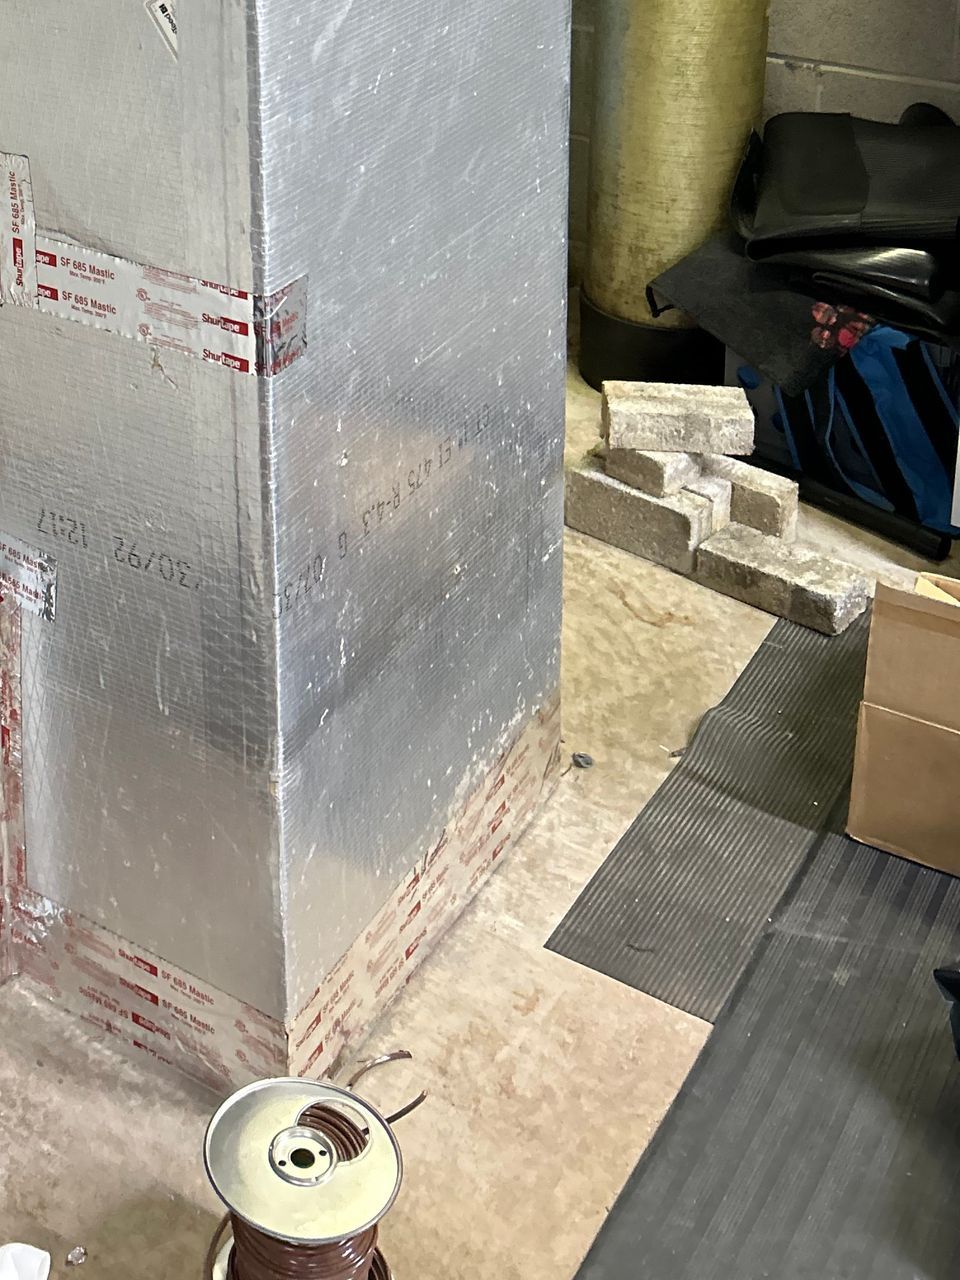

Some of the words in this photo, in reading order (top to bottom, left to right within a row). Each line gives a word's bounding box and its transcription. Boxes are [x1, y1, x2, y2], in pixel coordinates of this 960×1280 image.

[7, 170, 18, 201] Mastic
[10, 202, 19, 219] 685
[11, 220, 20, 234] SF
[12, 247, 24, 287] Shurtape
[60, 257, 71, 268] SF
[73, 260, 87, 273] 685
[89, 265, 115, 280] Mastic
[62, 290, 72, 301] SF
[74, 295, 88, 307] 685
[91, 299, 117, 315] Mastic
[202, 312, 240, 334] Shurtape
[203, 349, 241, 369] Shurtape
[407, 457, 434, 496] 475
[361, 482, 401, 536] R-4.3
[189, 984, 215, 1005] Mastic
[190, 1014, 215, 1034] Mastic
